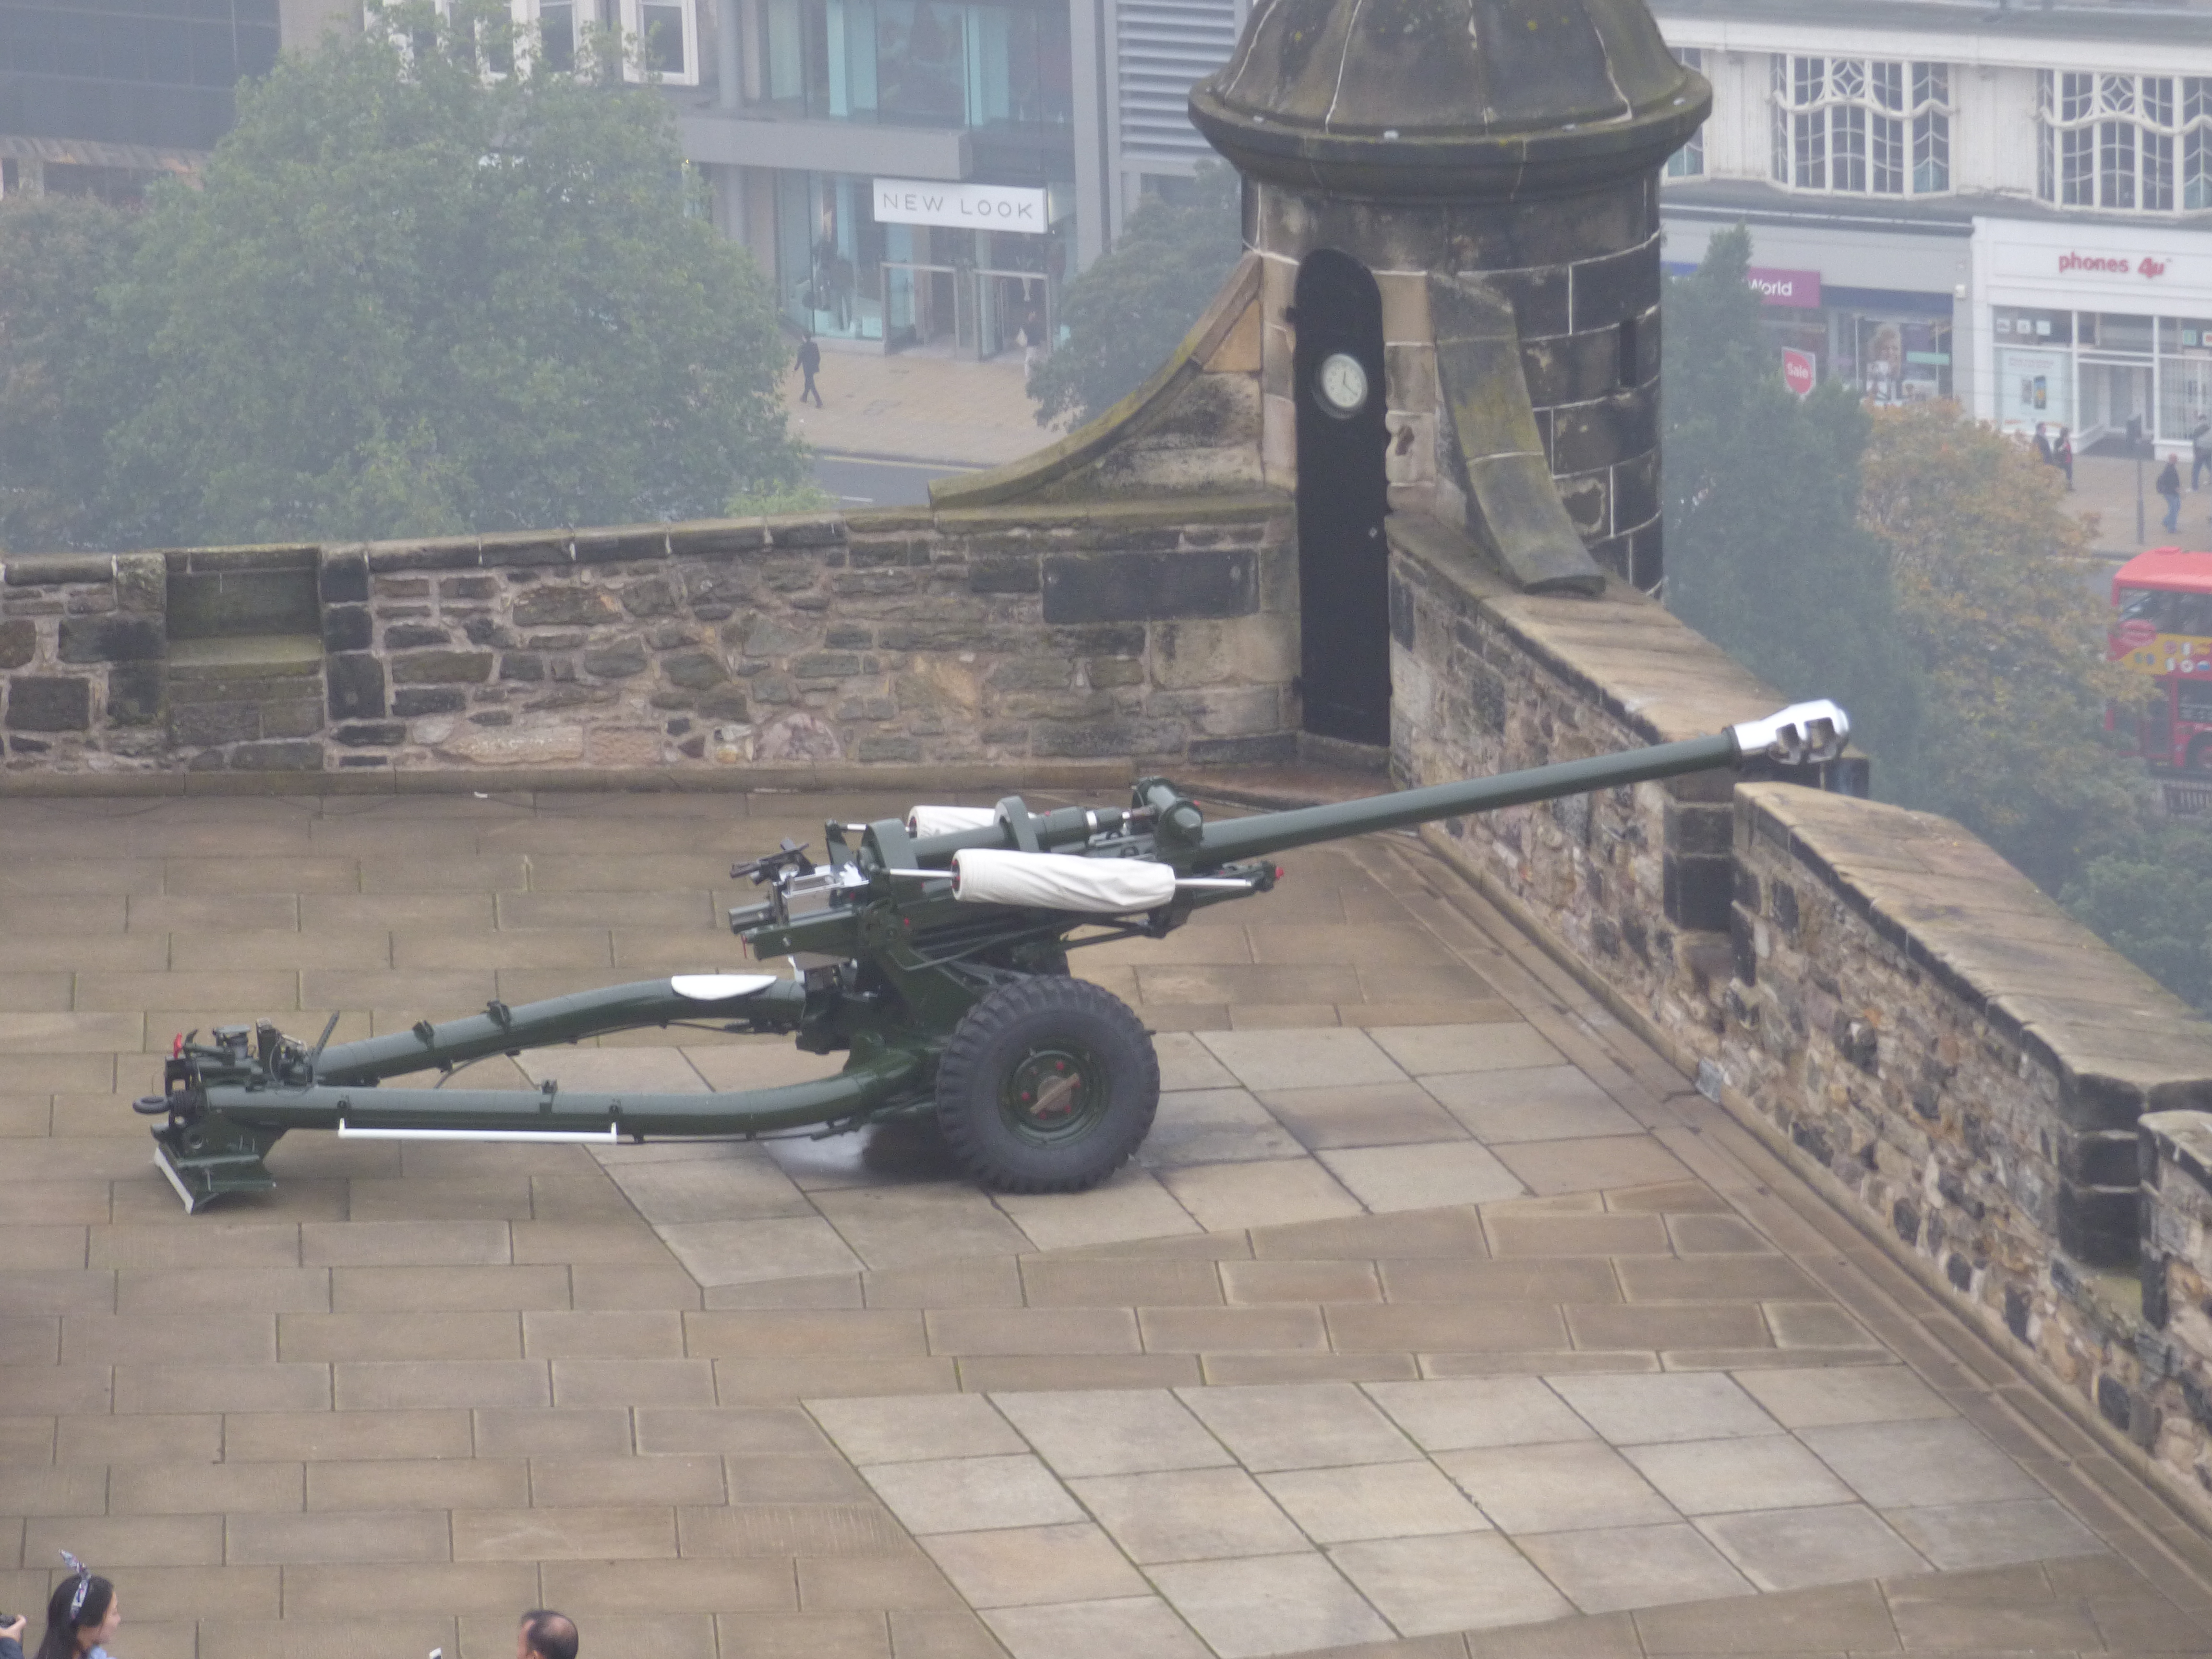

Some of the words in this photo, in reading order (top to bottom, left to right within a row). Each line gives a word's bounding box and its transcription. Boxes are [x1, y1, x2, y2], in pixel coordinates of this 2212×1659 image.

[883, 193, 943, 212] NEW
[960, 198, 1032, 219] LOOK
[2058, 251, 2129, 274] phones
[2138, 257, 2164, 279] 4u
[1748, 279, 1792, 296] World
[1787, 362, 1809, 379] Sale
